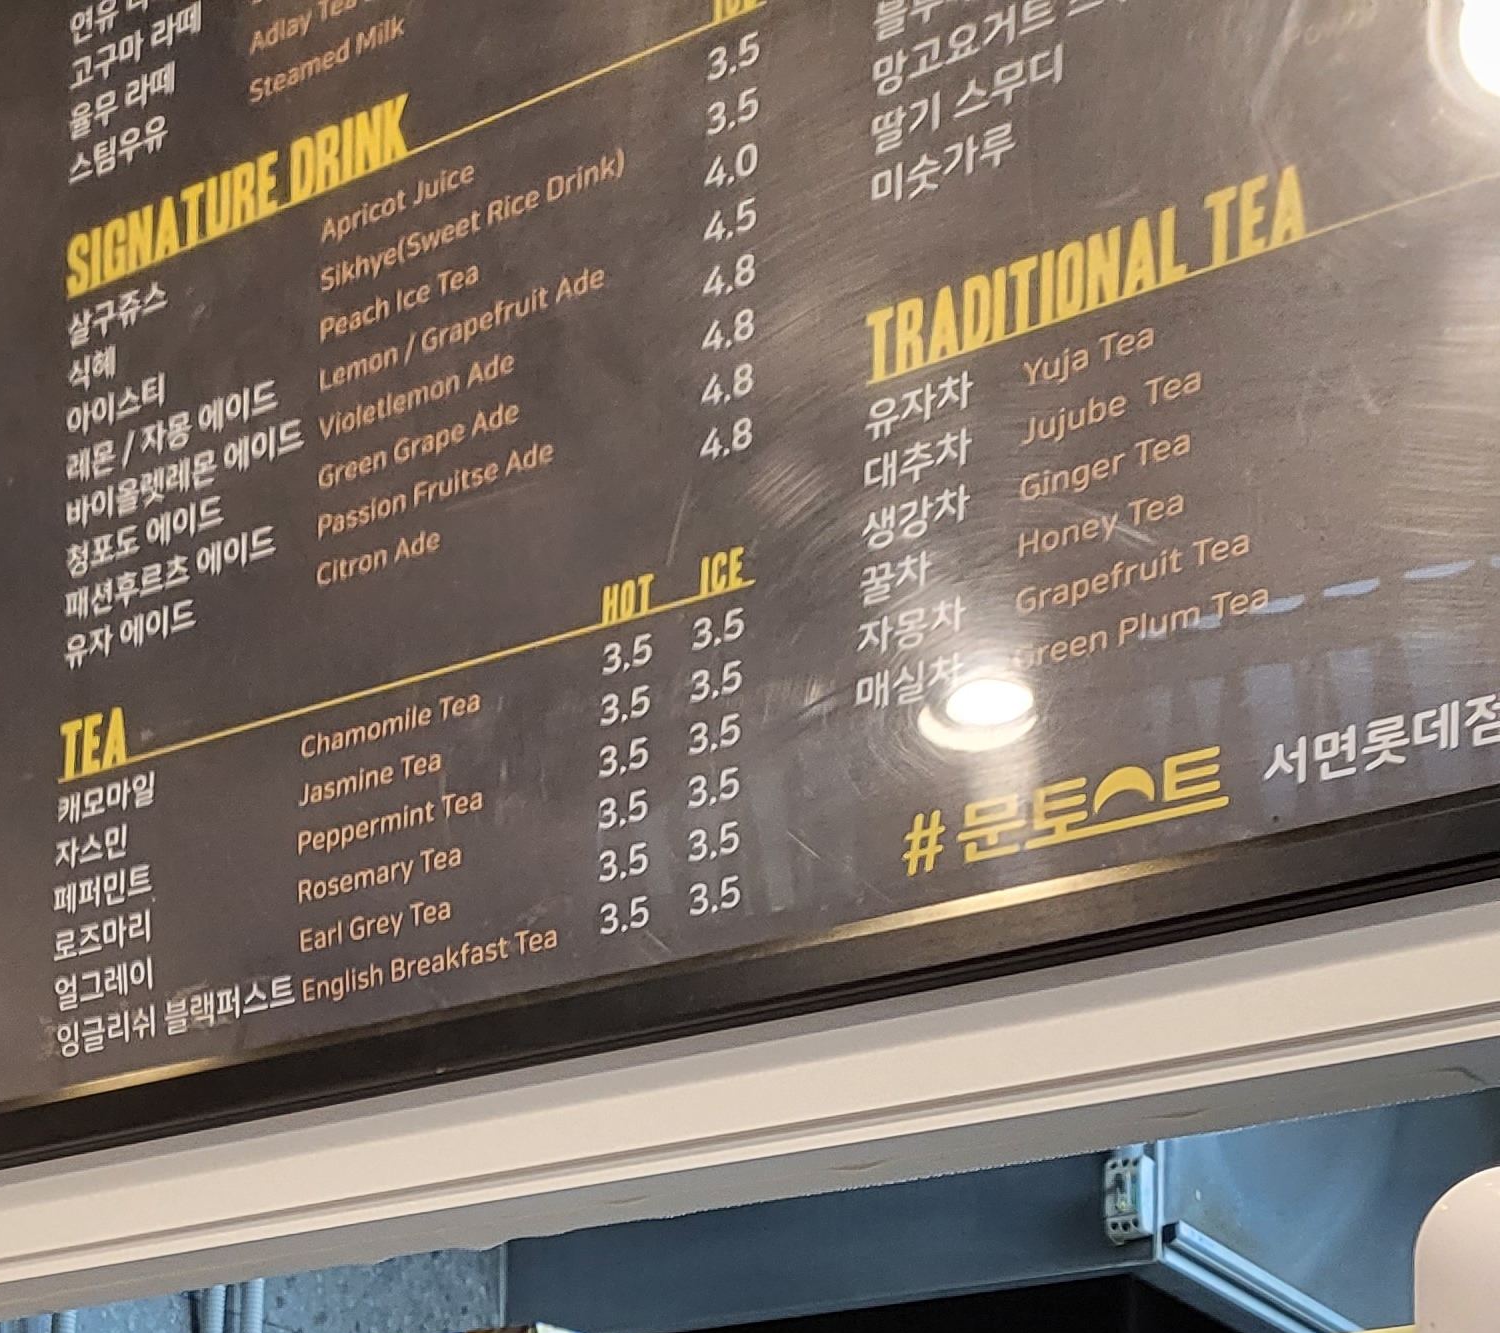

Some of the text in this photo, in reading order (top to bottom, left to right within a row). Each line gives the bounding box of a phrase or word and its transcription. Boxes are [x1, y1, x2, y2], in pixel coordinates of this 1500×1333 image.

[125, 61, 176, 107] 라떼
[250, 16, 406, 103] Steamed Milk
[871, 44, 1065, 155] 딸기 스무디
[69, 115, 168, 184] 스팀우유
[704, 143, 758, 188] 4.0
[870, 123, 1016, 202] 미숫가루
[66, 93, 409, 298] SIGNATURE DRINK
[321, 163, 474, 243] Apricot Juice
[487, 190, 540, 226] Rice
[547, 148, 625, 202] Drink)
[704, 198, 757, 243] 4.5
[320, 264, 479, 343] Peach Ice Tea
[865, 164, 1306, 386] TRADITIONAL TEA
[68, 344, 117, 391] 식혜
[1023, 326, 1155, 388] Yuja Tea
[66, 372, 165, 435] 아이스티
[319, 353, 515, 441] Violetlemon Ade
[864, 370, 974, 441] 유자차
[1020, 370, 1201, 446] Jujube Tea
[224, 418, 305, 472] 에이드
[318, 403, 520, 490] Green Grape Ade
[863, 427, 973, 489] 대추차
[1020, 432, 1191, 501] Ginger Tea
[318, 441, 555, 541] Passion Fruitse Ade
[862, 485, 970, 550] 생강차
[66, 496, 224, 579] 청포도 에이드
[1018, 492, 1184, 558] Honey Tea
[316, 531, 441, 587] Citron Ade
[602, 547, 745, 627] HOT ICE
[860, 550, 933, 607] 꿀차
[1015, 533, 1250, 614] Grapefruit Tea
[64, 600, 196, 670] 유자 에이드
[603, 607, 745, 675] 3.5 3.5
[59, 706, 128, 783] TEA
[301, 694, 481, 759] Chamomile Tea
[1263, 694, 1500, 785] 서면롯데점
[58, 771, 155, 824] 캐모마일
[298, 753, 441, 807] Jasmine Tea
[55, 823, 128, 869] 자스민
[297, 791, 483, 856] Peppermint Tea
[53, 864, 152, 914] 페퍼민트
[297, 847, 462, 904] Rosemary Tea
[600, 875, 741, 936] 3.5 3.5
[53, 909, 150, 962] 로즈마리
[300, 901, 451, 953] Earl Grey Tea
[54, 954, 153, 1012] 얼그레이
[302, 928, 558, 1003] English Breakfast Tea
[57, 1004, 156, 1058] 잉글리쉬
